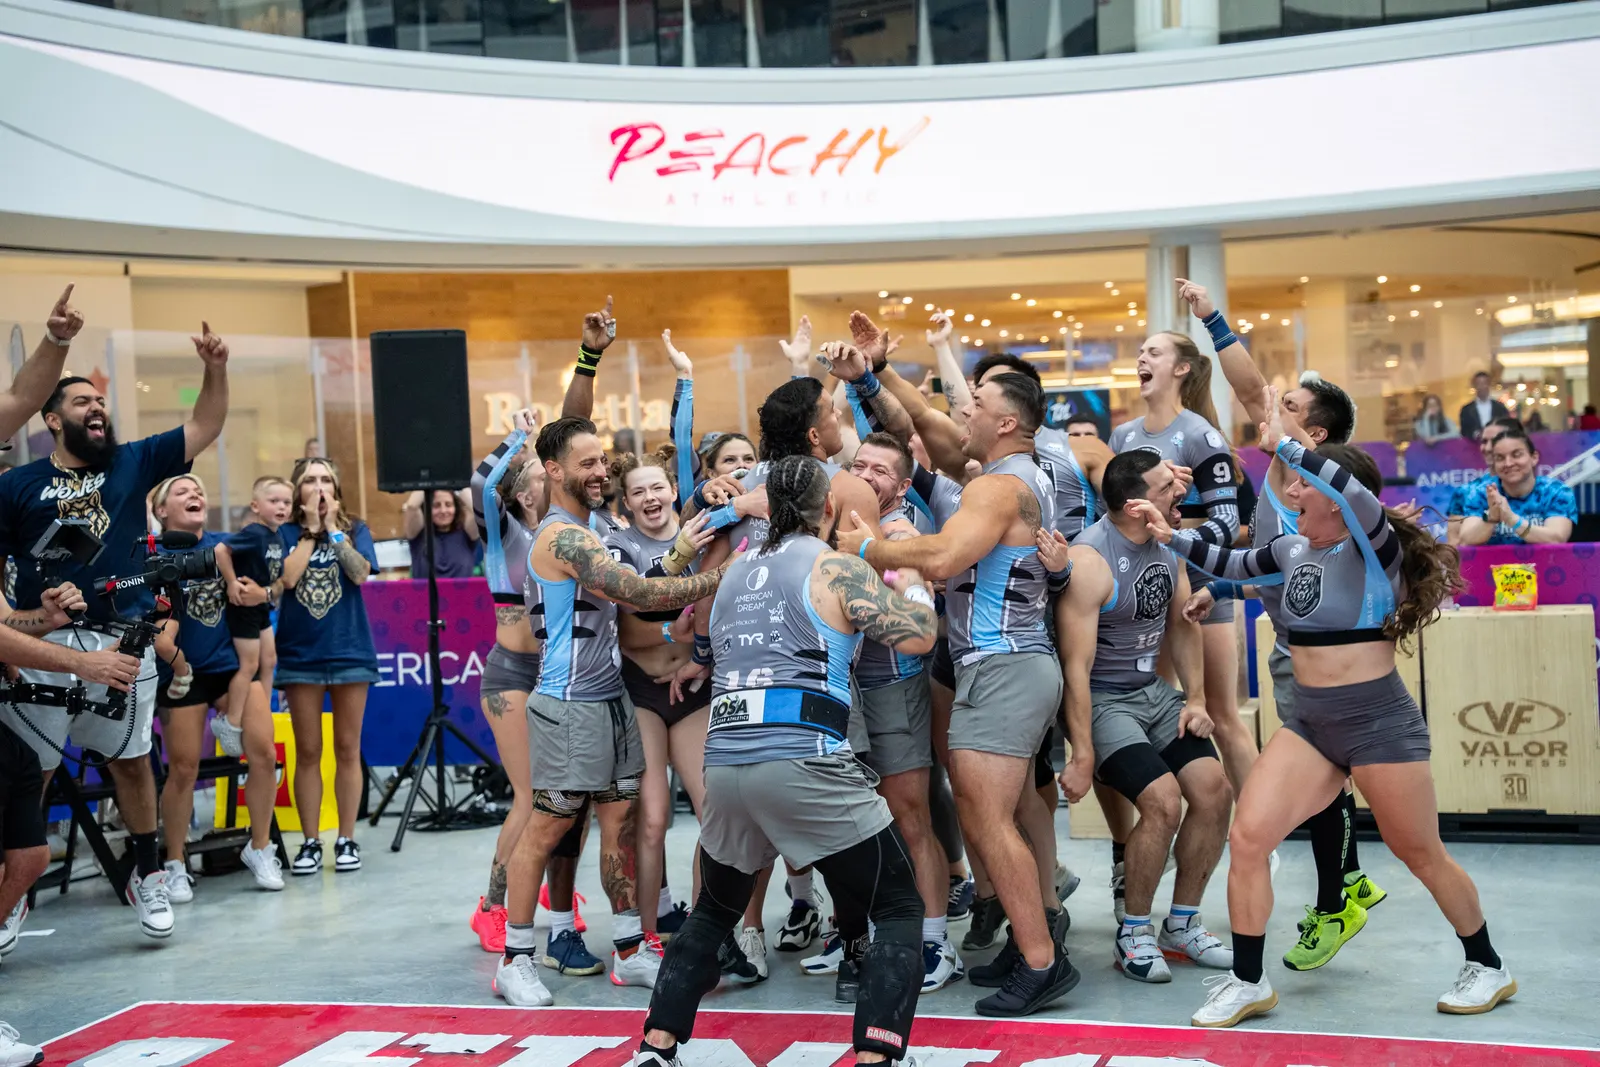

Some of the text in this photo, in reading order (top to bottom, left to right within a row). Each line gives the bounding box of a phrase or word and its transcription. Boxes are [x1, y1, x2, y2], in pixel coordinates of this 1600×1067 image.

[608, 116, 931, 182] PEACHY
[1212, 461, 1232, 484] 9
[115, 576, 145, 590] RONIN
[734, 589, 774, 605] AMERICAN
[737, 601, 767, 613] DREAM
[738, 632, 764, 647] TYR
[374, 650, 485, 687] ERICA
[711, 699, 748, 720] ROSA
[1483, 701, 1536, 735] VF
[1460, 741, 1568, 757] VALOR
[1463, 759, 1567, 768] FITNESS
[1504, 777, 1528, 796] 30
[867, 1028, 902, 1047] GANGSTA
